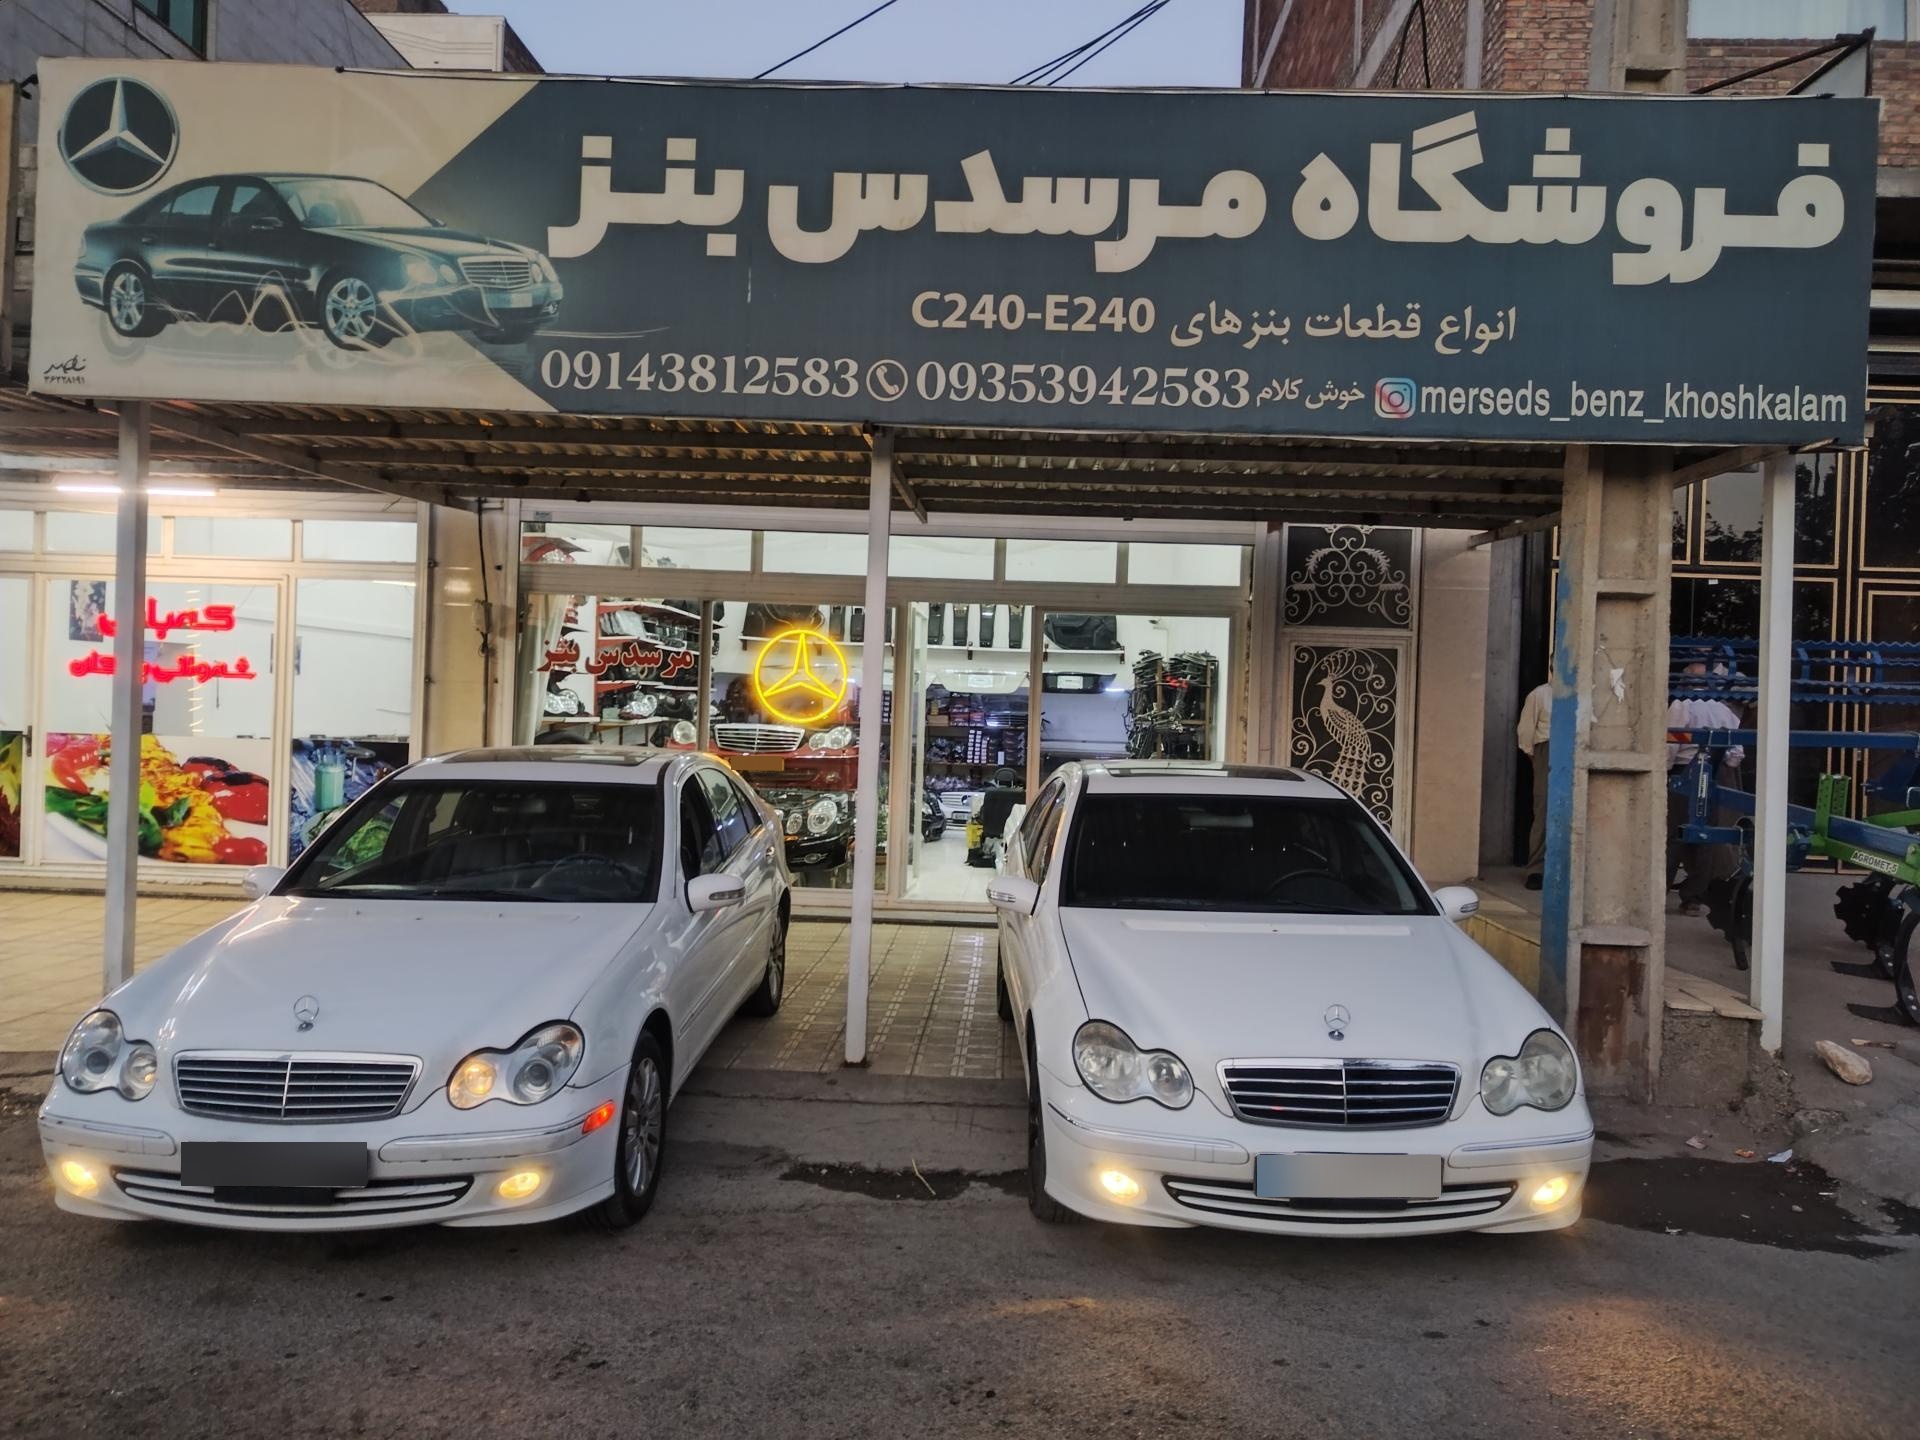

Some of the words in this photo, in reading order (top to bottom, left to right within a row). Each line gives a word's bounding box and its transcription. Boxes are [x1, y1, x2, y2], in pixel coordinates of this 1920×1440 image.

[547, 134, 745, 259] بنز
[767, 148, 1268, 273] مرسدس
[1292, 110, 1845, 286] فروشگاه
[910, 290, 1157, 335] C240-E240
[1304, 301, 1422, 340] قطعات
[1434, 305, 1517, 355] انواع
[540, 349, 860, 399] 09143812583
[915, 360, 1250, 408] 09353942583
[1256, 377, 1304, 407] کلام
[1305, 380, 1366, 410] خوش
[1420, 379, 1848, 424] merseds_benz_khoshkalam
[536, 639, 581, 674] بنز
[584, 641, 695, 678] مرسدس
[1852, 850, 1898, 874] AGROMET-5
